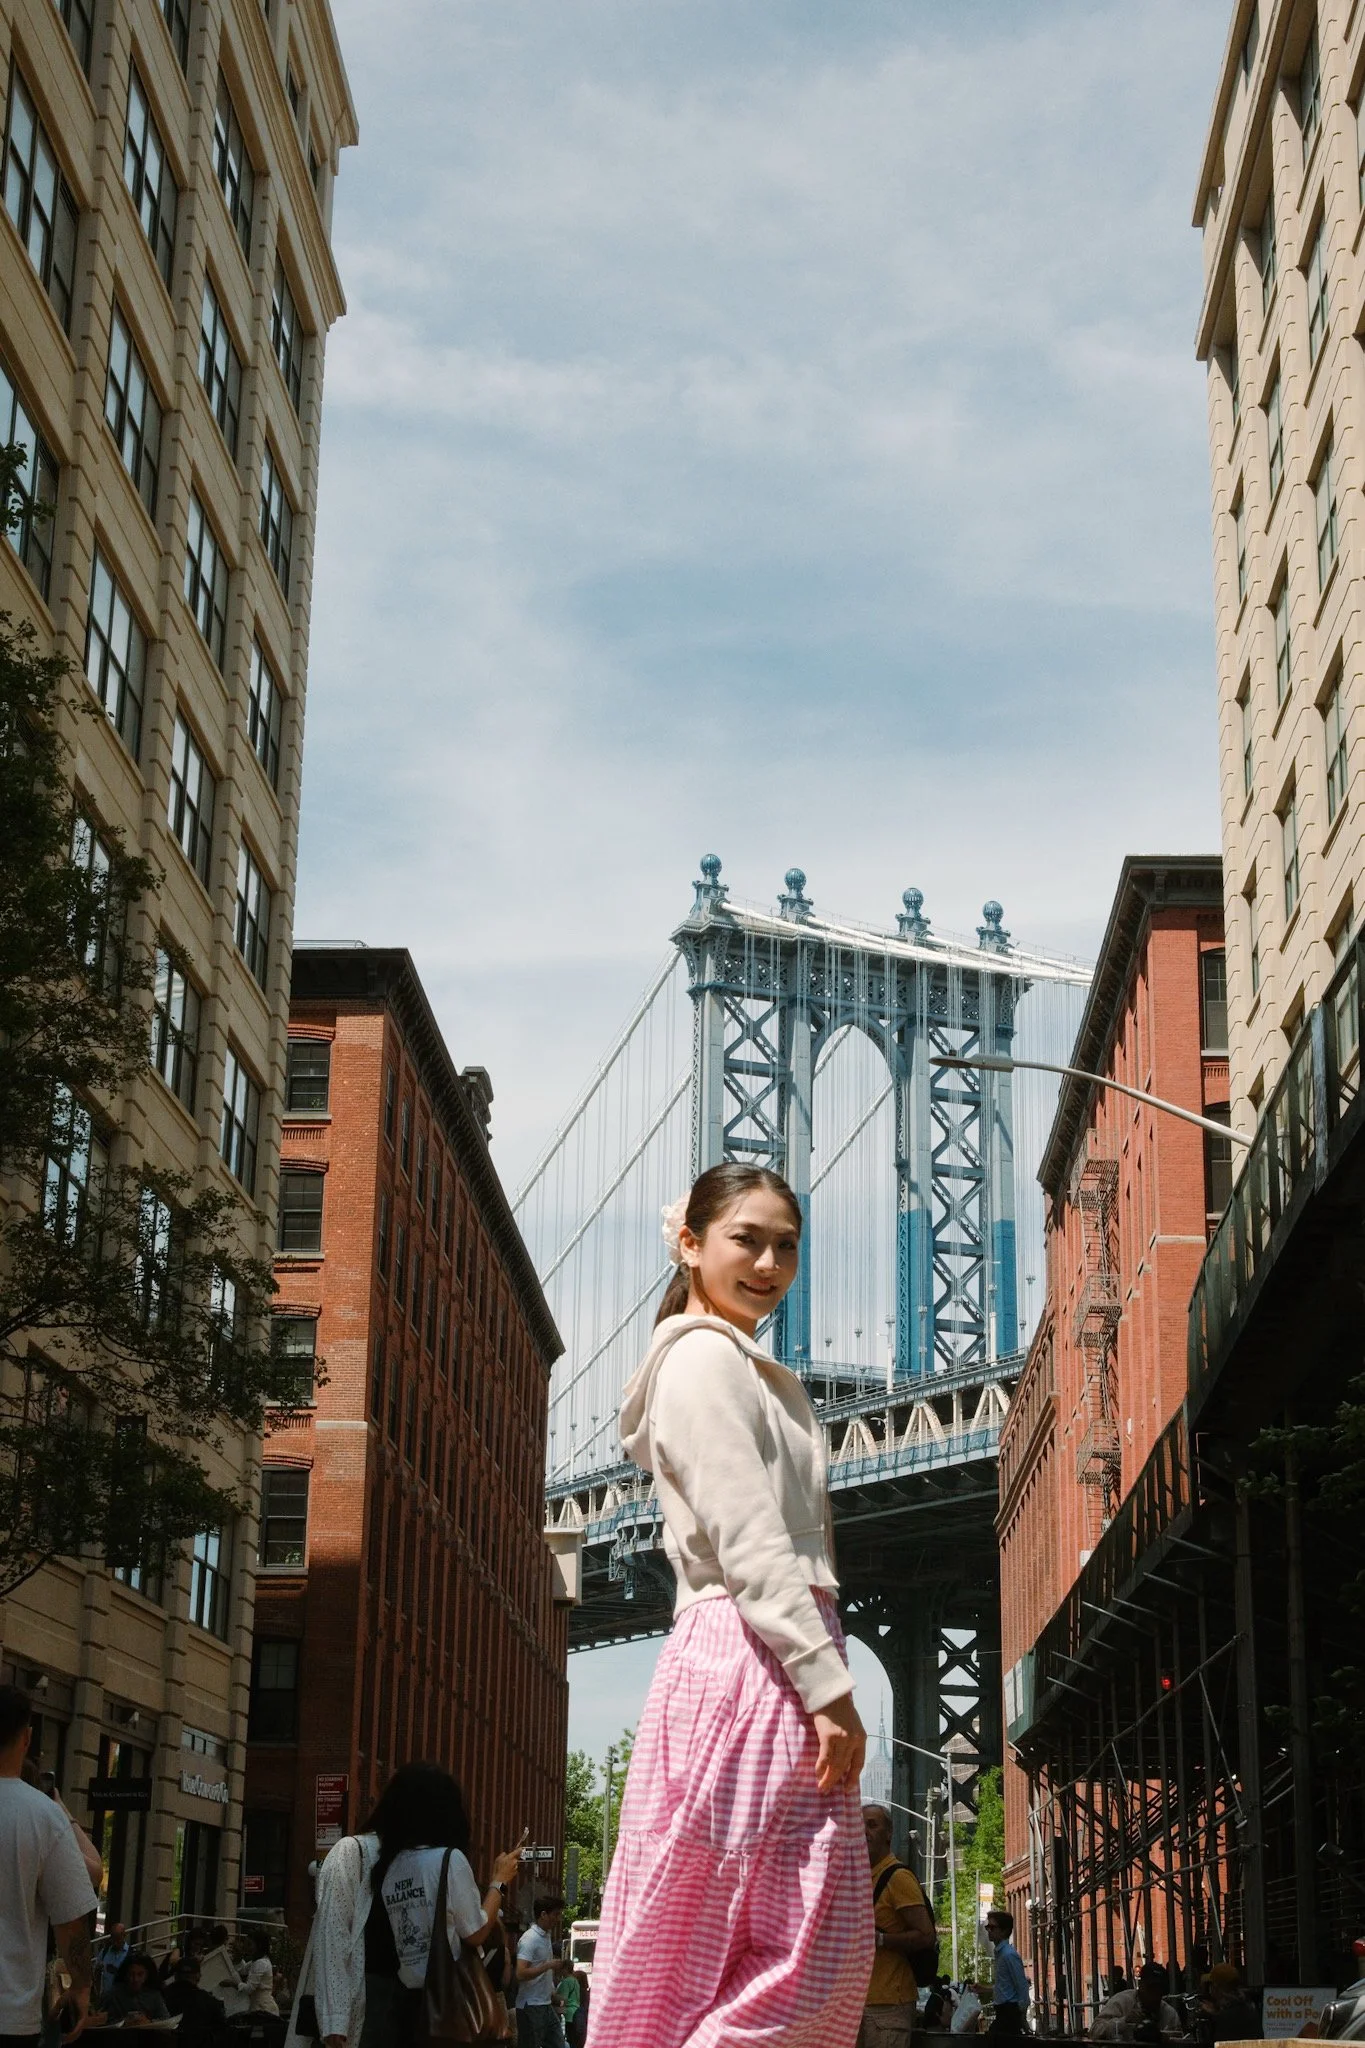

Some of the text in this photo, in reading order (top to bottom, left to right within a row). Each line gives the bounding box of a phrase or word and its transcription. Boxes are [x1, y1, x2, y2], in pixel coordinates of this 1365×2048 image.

[394, 1878, 414, 1892] NEW
[385, 1887, 425, 1905] BALANCE
[1266, 1995, 1313, 2006] Cool Off
[1266, 2007, 1321, 2019] with a Po
